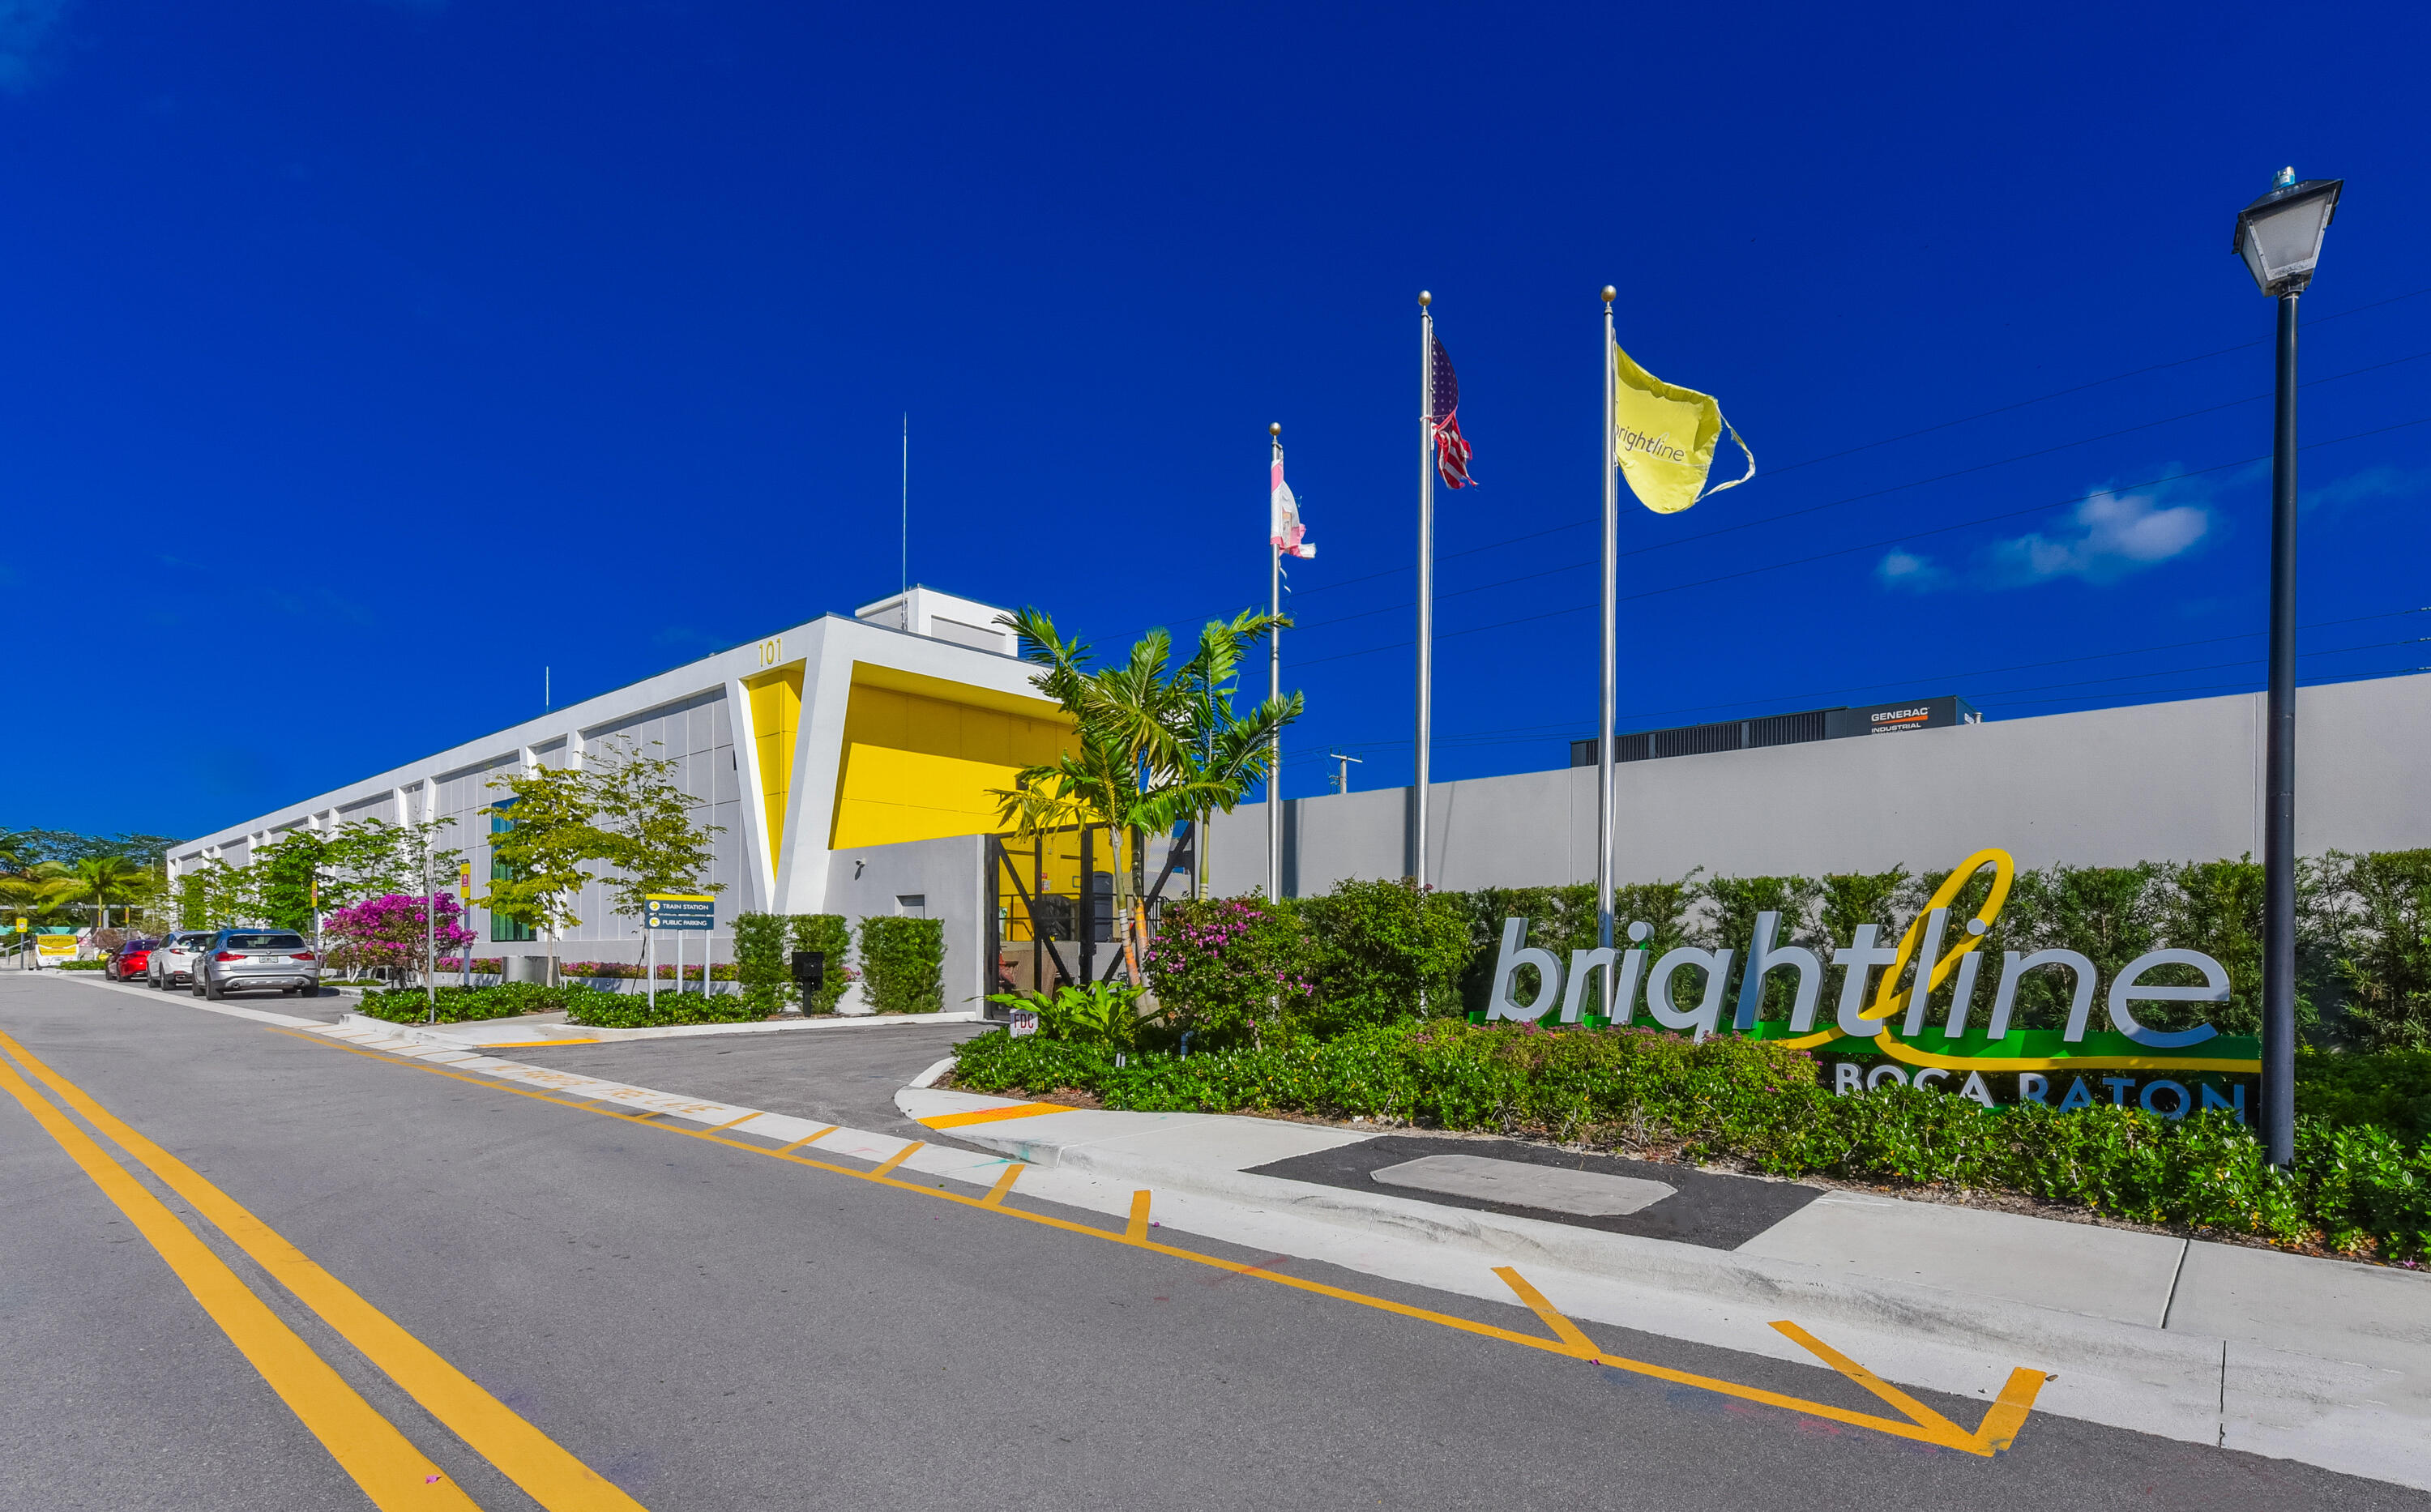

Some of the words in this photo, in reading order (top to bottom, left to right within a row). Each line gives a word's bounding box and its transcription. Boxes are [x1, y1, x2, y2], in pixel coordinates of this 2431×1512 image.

[758, 638, 781, 667] 101
[1871, 707, 1929, 722] GENERAC
[1871, 722, 1922, 733] INDUSTRIAL
[1485, 907, 2230, 1048] brightline
[1014, 1013, 1034, 1028] FDC
[2019, 1073, 2245, 1124] RATON
